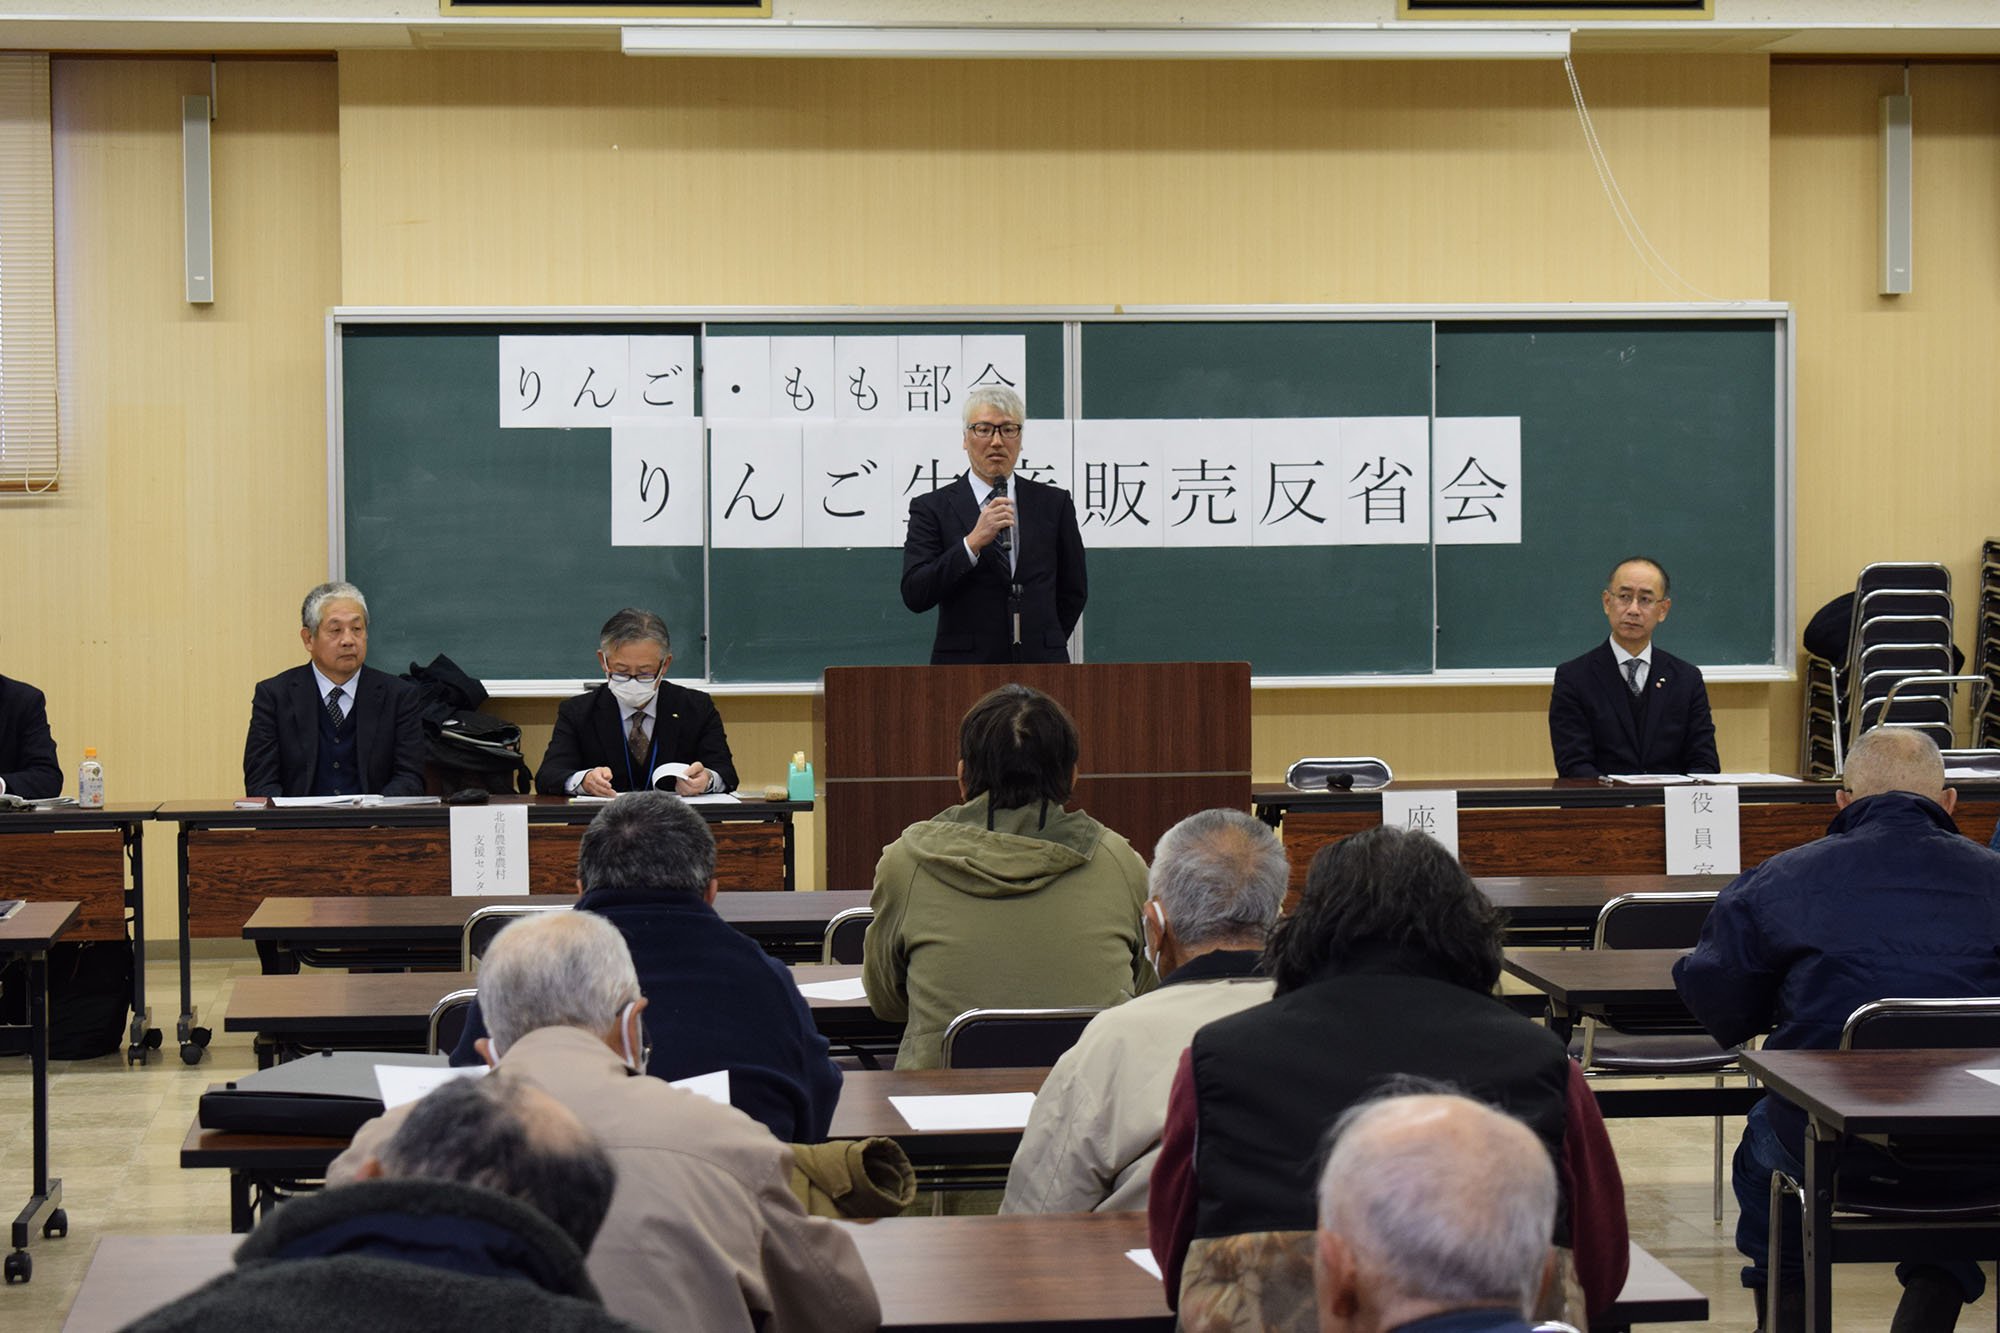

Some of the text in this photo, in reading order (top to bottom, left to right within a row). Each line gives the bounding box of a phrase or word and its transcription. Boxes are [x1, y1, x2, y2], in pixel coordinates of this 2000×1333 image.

[474, 834, 486, 896] 支援センタ
